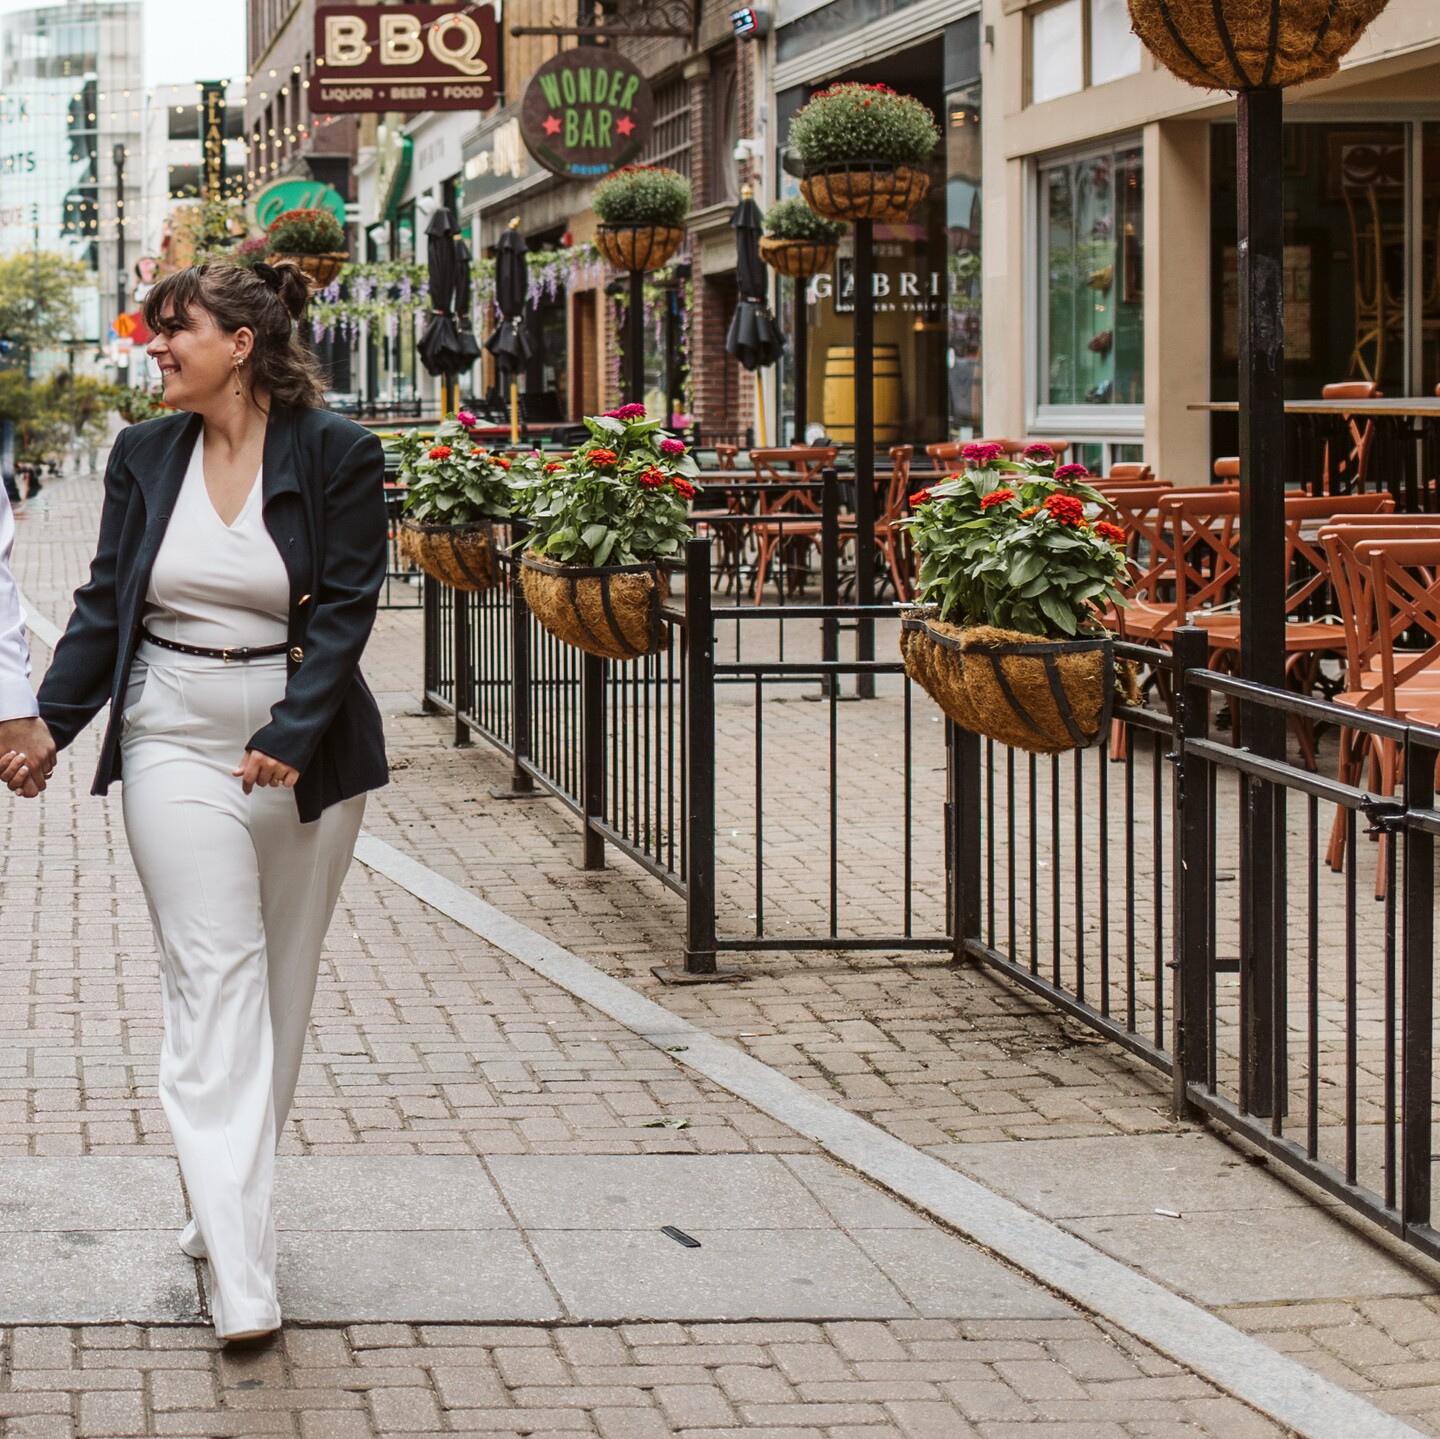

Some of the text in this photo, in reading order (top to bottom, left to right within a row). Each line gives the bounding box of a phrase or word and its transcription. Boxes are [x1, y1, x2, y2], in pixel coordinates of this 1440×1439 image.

[325, 12, 488, 76] BBQ
[321, 86, 484, 102] LIQUOR BEER FOOD
[539, 67, 640, 111] WONDER
[565, 108, 612, 148] BAR
